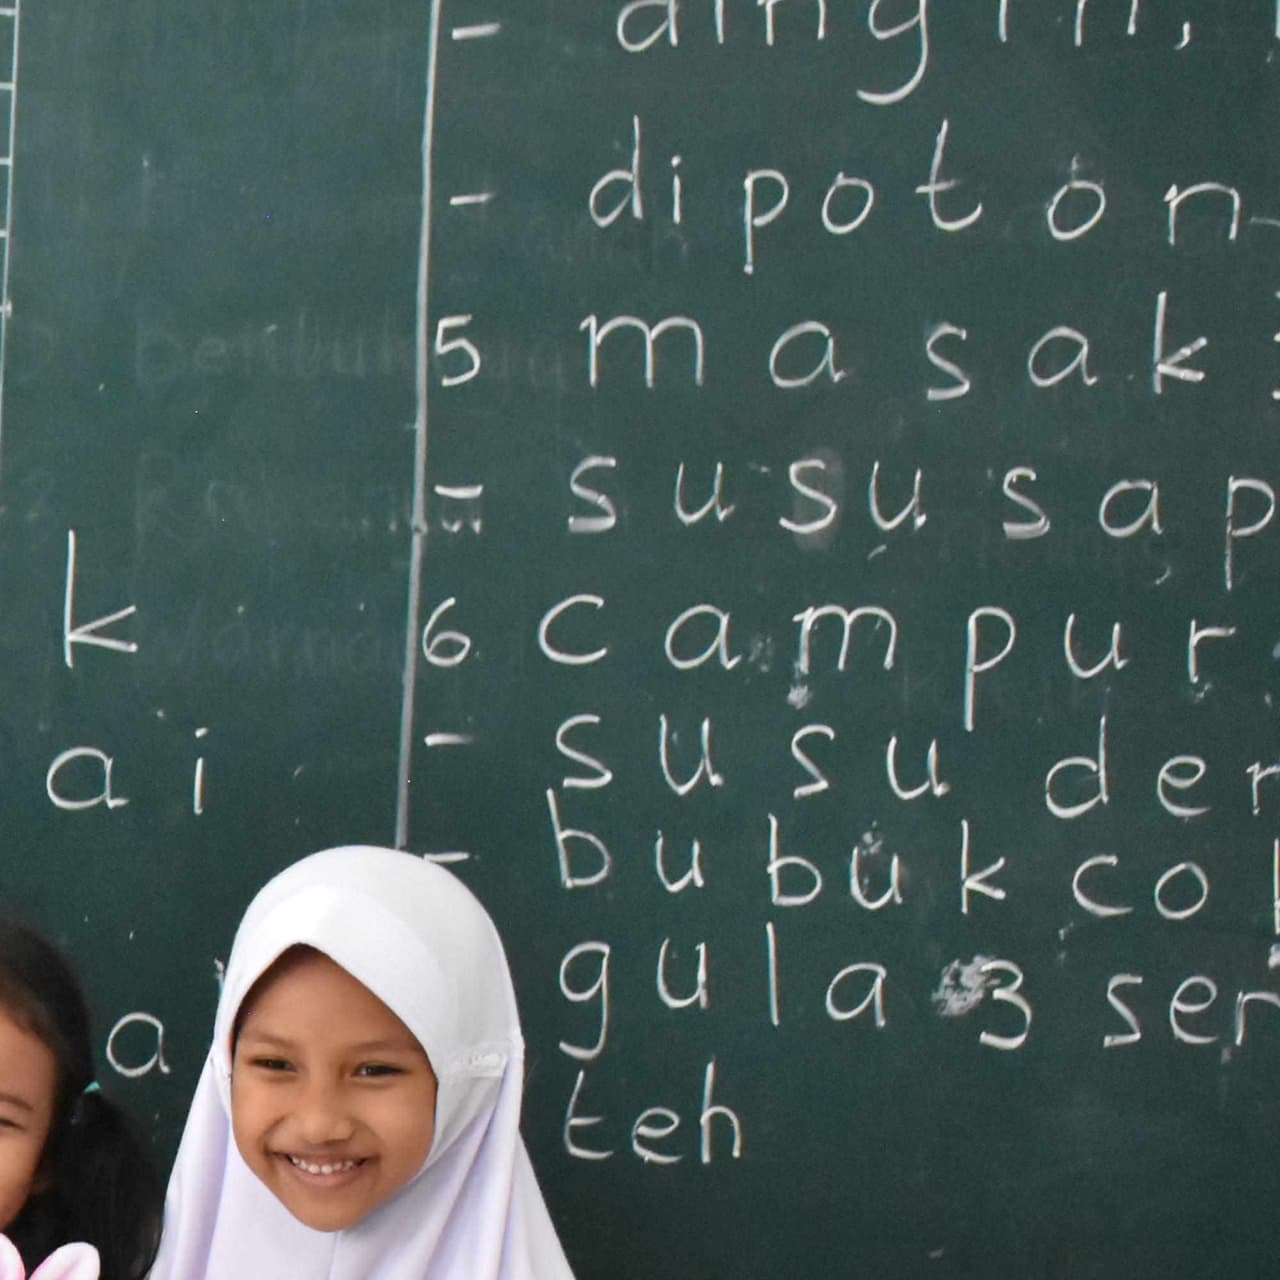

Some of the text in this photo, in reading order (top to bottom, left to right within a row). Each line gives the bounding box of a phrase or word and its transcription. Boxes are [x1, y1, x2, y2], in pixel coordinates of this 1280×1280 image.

[435, 315, 481, 387] 5
[423, 596, 471, 668] 6
[554, 713, 950, 800] susu
[546, 787, 1006, 914] bubuk
[558, 921, 887, 1060] gula
[562, 1058, 743, 1164] teh
